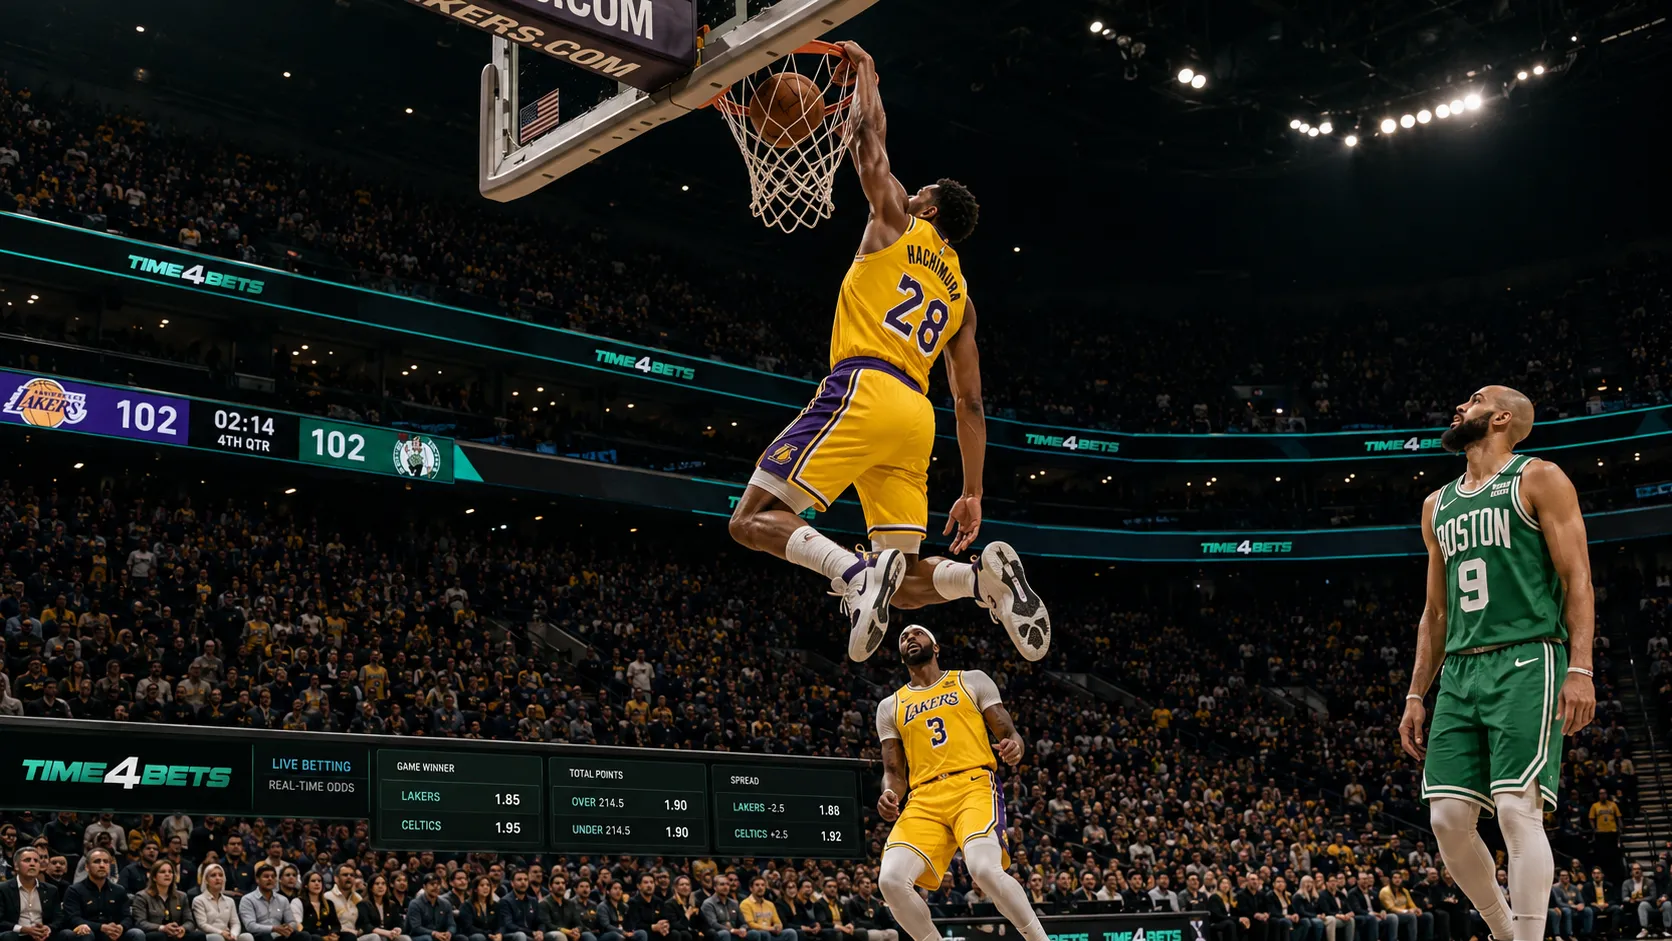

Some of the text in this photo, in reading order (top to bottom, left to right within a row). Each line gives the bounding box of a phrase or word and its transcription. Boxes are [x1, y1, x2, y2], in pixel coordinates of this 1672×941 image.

[415, 0, 641, 78] KERS.COM
[128, 254, 265, 295] TIME4BETS
[906, 244, 961, 302] HACHIMURA
[882, 272, 950, 357] 28
[595, 349, 696, 380] TIME4BETS
[9, 387, 84, 421] LAKERS
[117, 400, 177, 436] 102
[214, 410, 275, 437] 02:14
[217, 435, 271, 452] 4TH QTR
[311, 429, 365, 462] 102
[1025, 433, 1120, 453] TIME4BETS
[1364, 437, 1442, 451] TIME4BE
[1436, 507, 1511, 564] BOSTON
[1201, 540, 1292, 554] TIME4BETS
[1457, 557, 1489, 613] 9
[903, 692, 960, 726] LAKERS
[926, 716, 948, 749] 3
[22, 757, 232, 789] TIME4BETS
[272, 758, 352, 772] LIVE BETTING
[396, 762, 455, 773] GAME WINNER
[569, 768, 624, 780] TOTAL POINTS
[268, 780, 355, 793] REAL-TIME ODDS
[730, 775, 760, 785] SPREAD
[401, 791, 521, 806] LAKERS 1.85
[571, 796, 688, 811] OVER 214.5 1.90
[733, 803, 840, 816] LAKERS -2.5 1.88
[401, 820, 521, 834] CELTICS 1.95
[572, 825, 689, 838] UNDER 214.5 1.90
[734, 829, 842, 842] CELTICS +2.5 1.92
